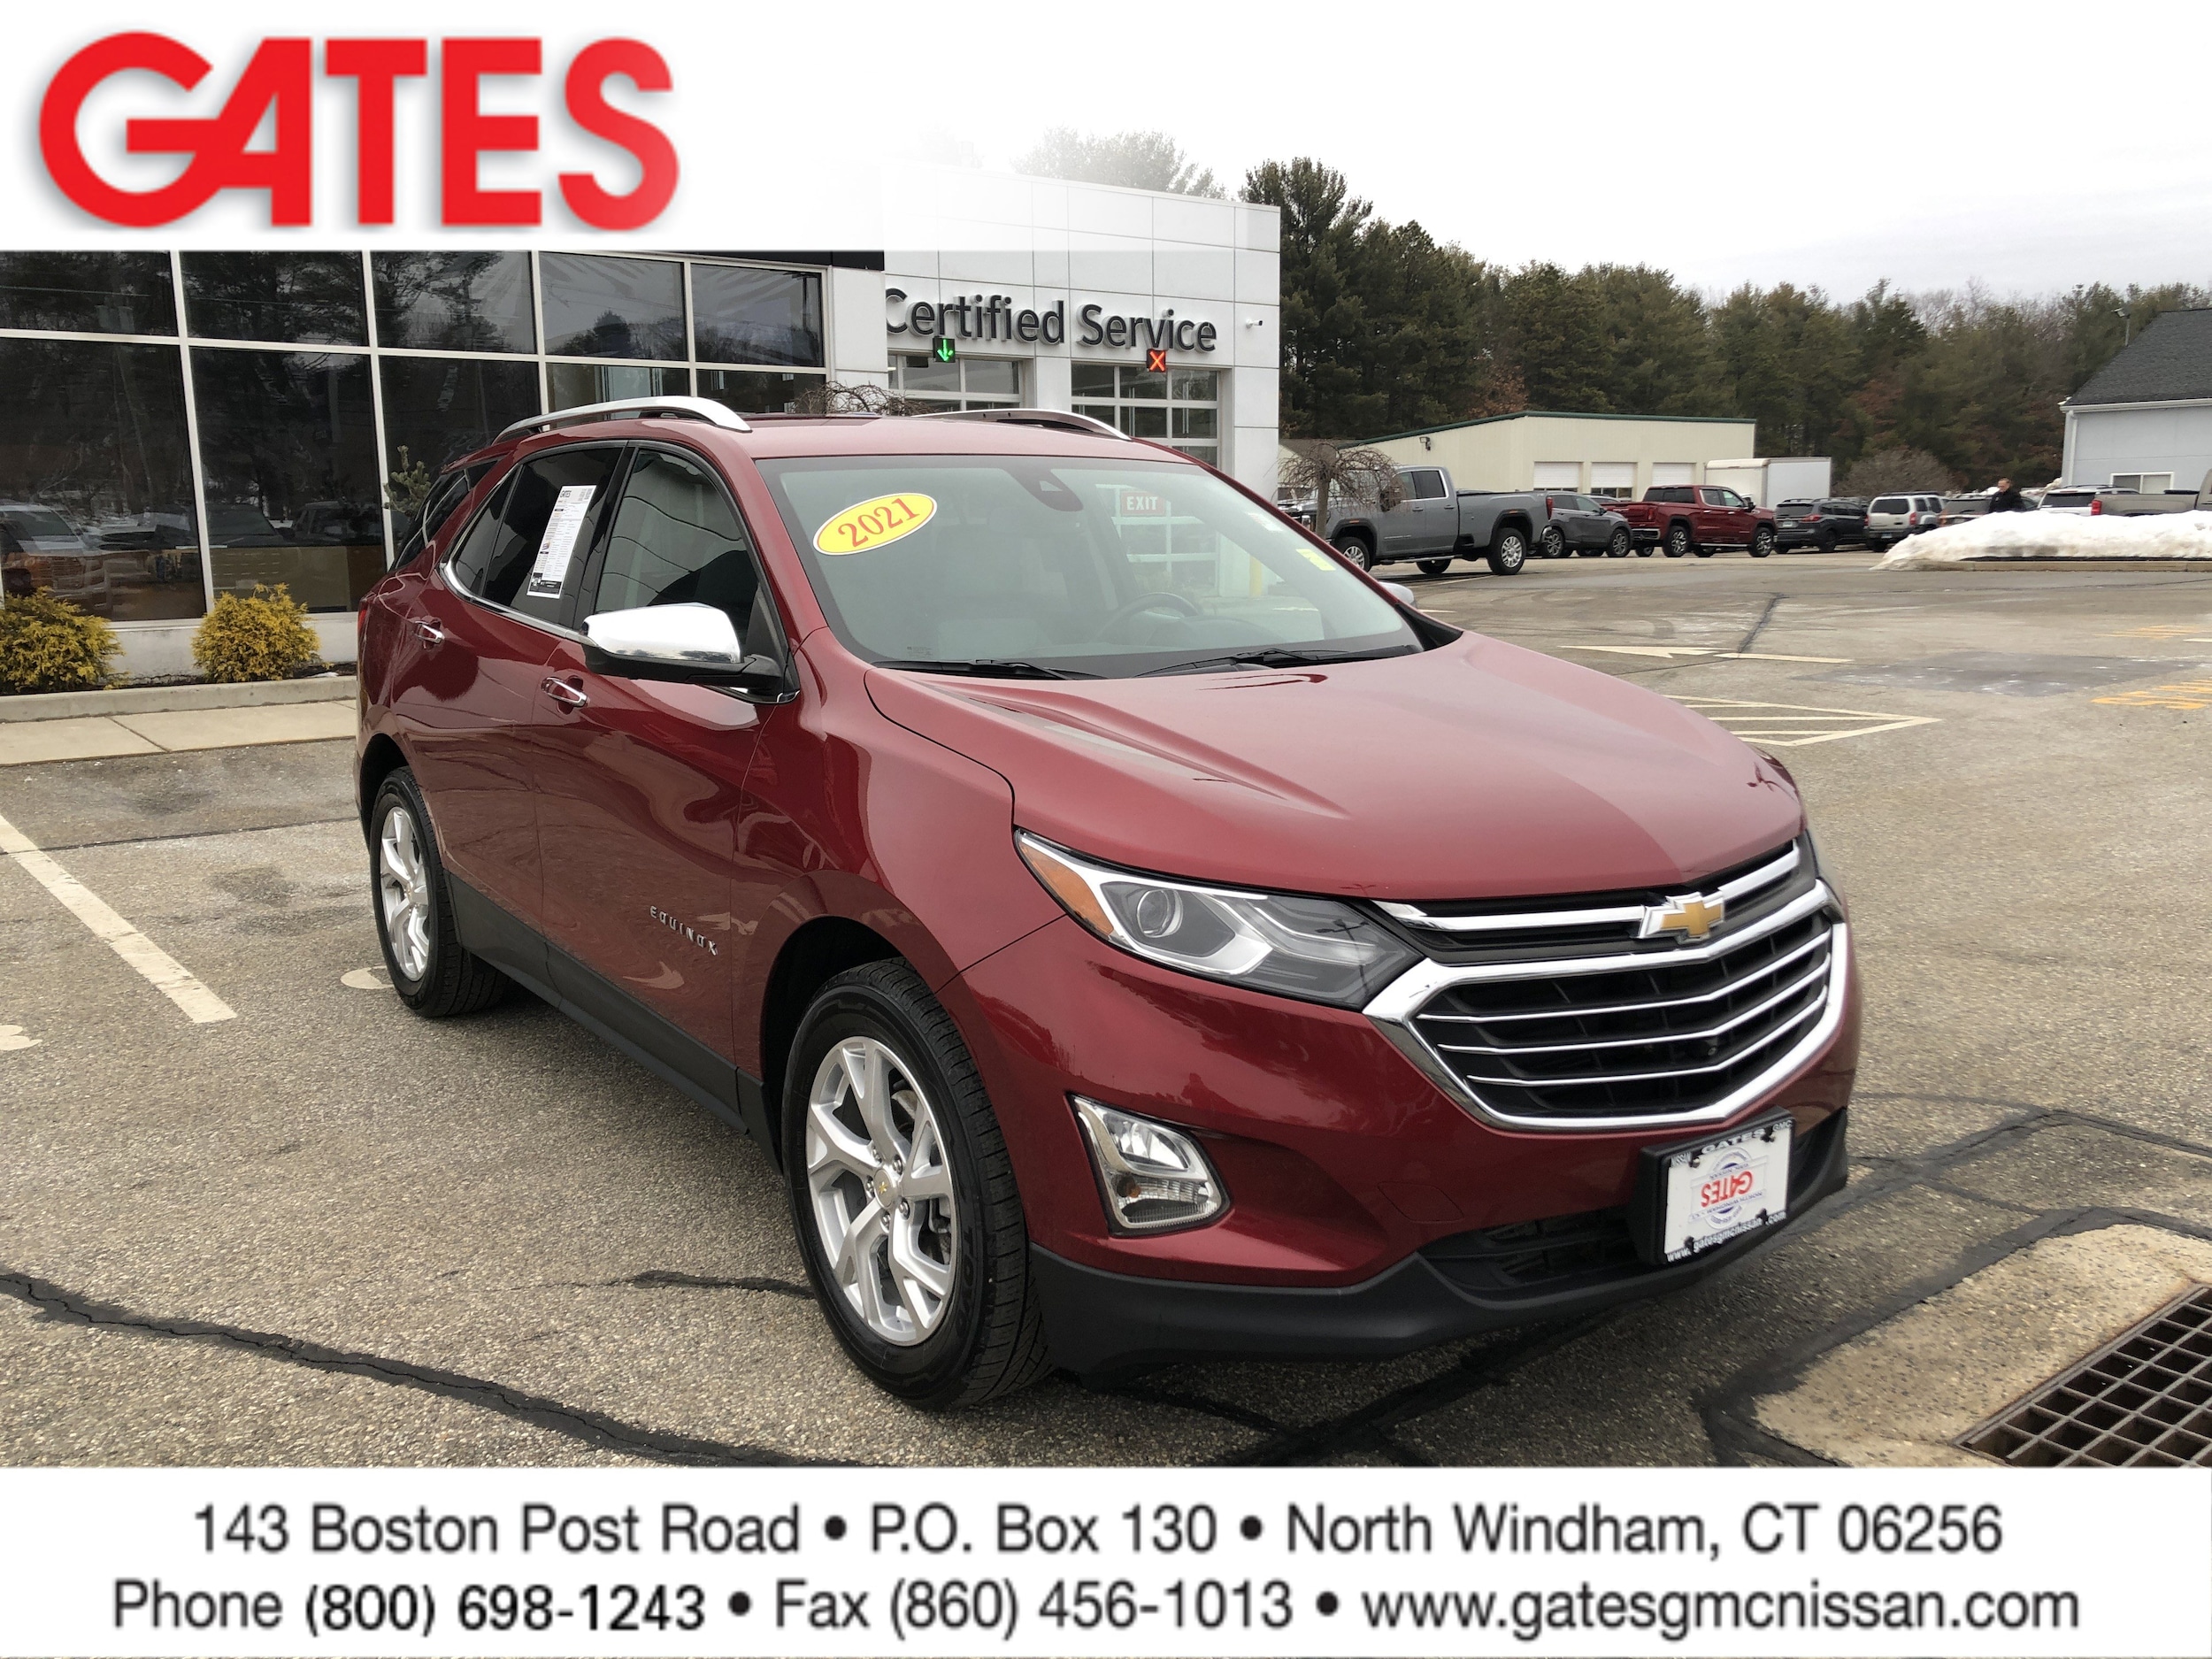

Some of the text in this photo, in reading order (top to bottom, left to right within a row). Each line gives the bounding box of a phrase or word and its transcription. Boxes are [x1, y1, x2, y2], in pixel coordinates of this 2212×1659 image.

[886, 288, 1217, 353] Certified Service
[837, 497, 920, 548] 2021
[1126, 495, 1158, 511] EXIT
[649, 905, 718, 956] EQUINOX
[1701, 1127, 1767, 1155] GATES
[1772, 1119, 1793, 1133] GMC
[1700, 1170, 1754, 1209] GATES
